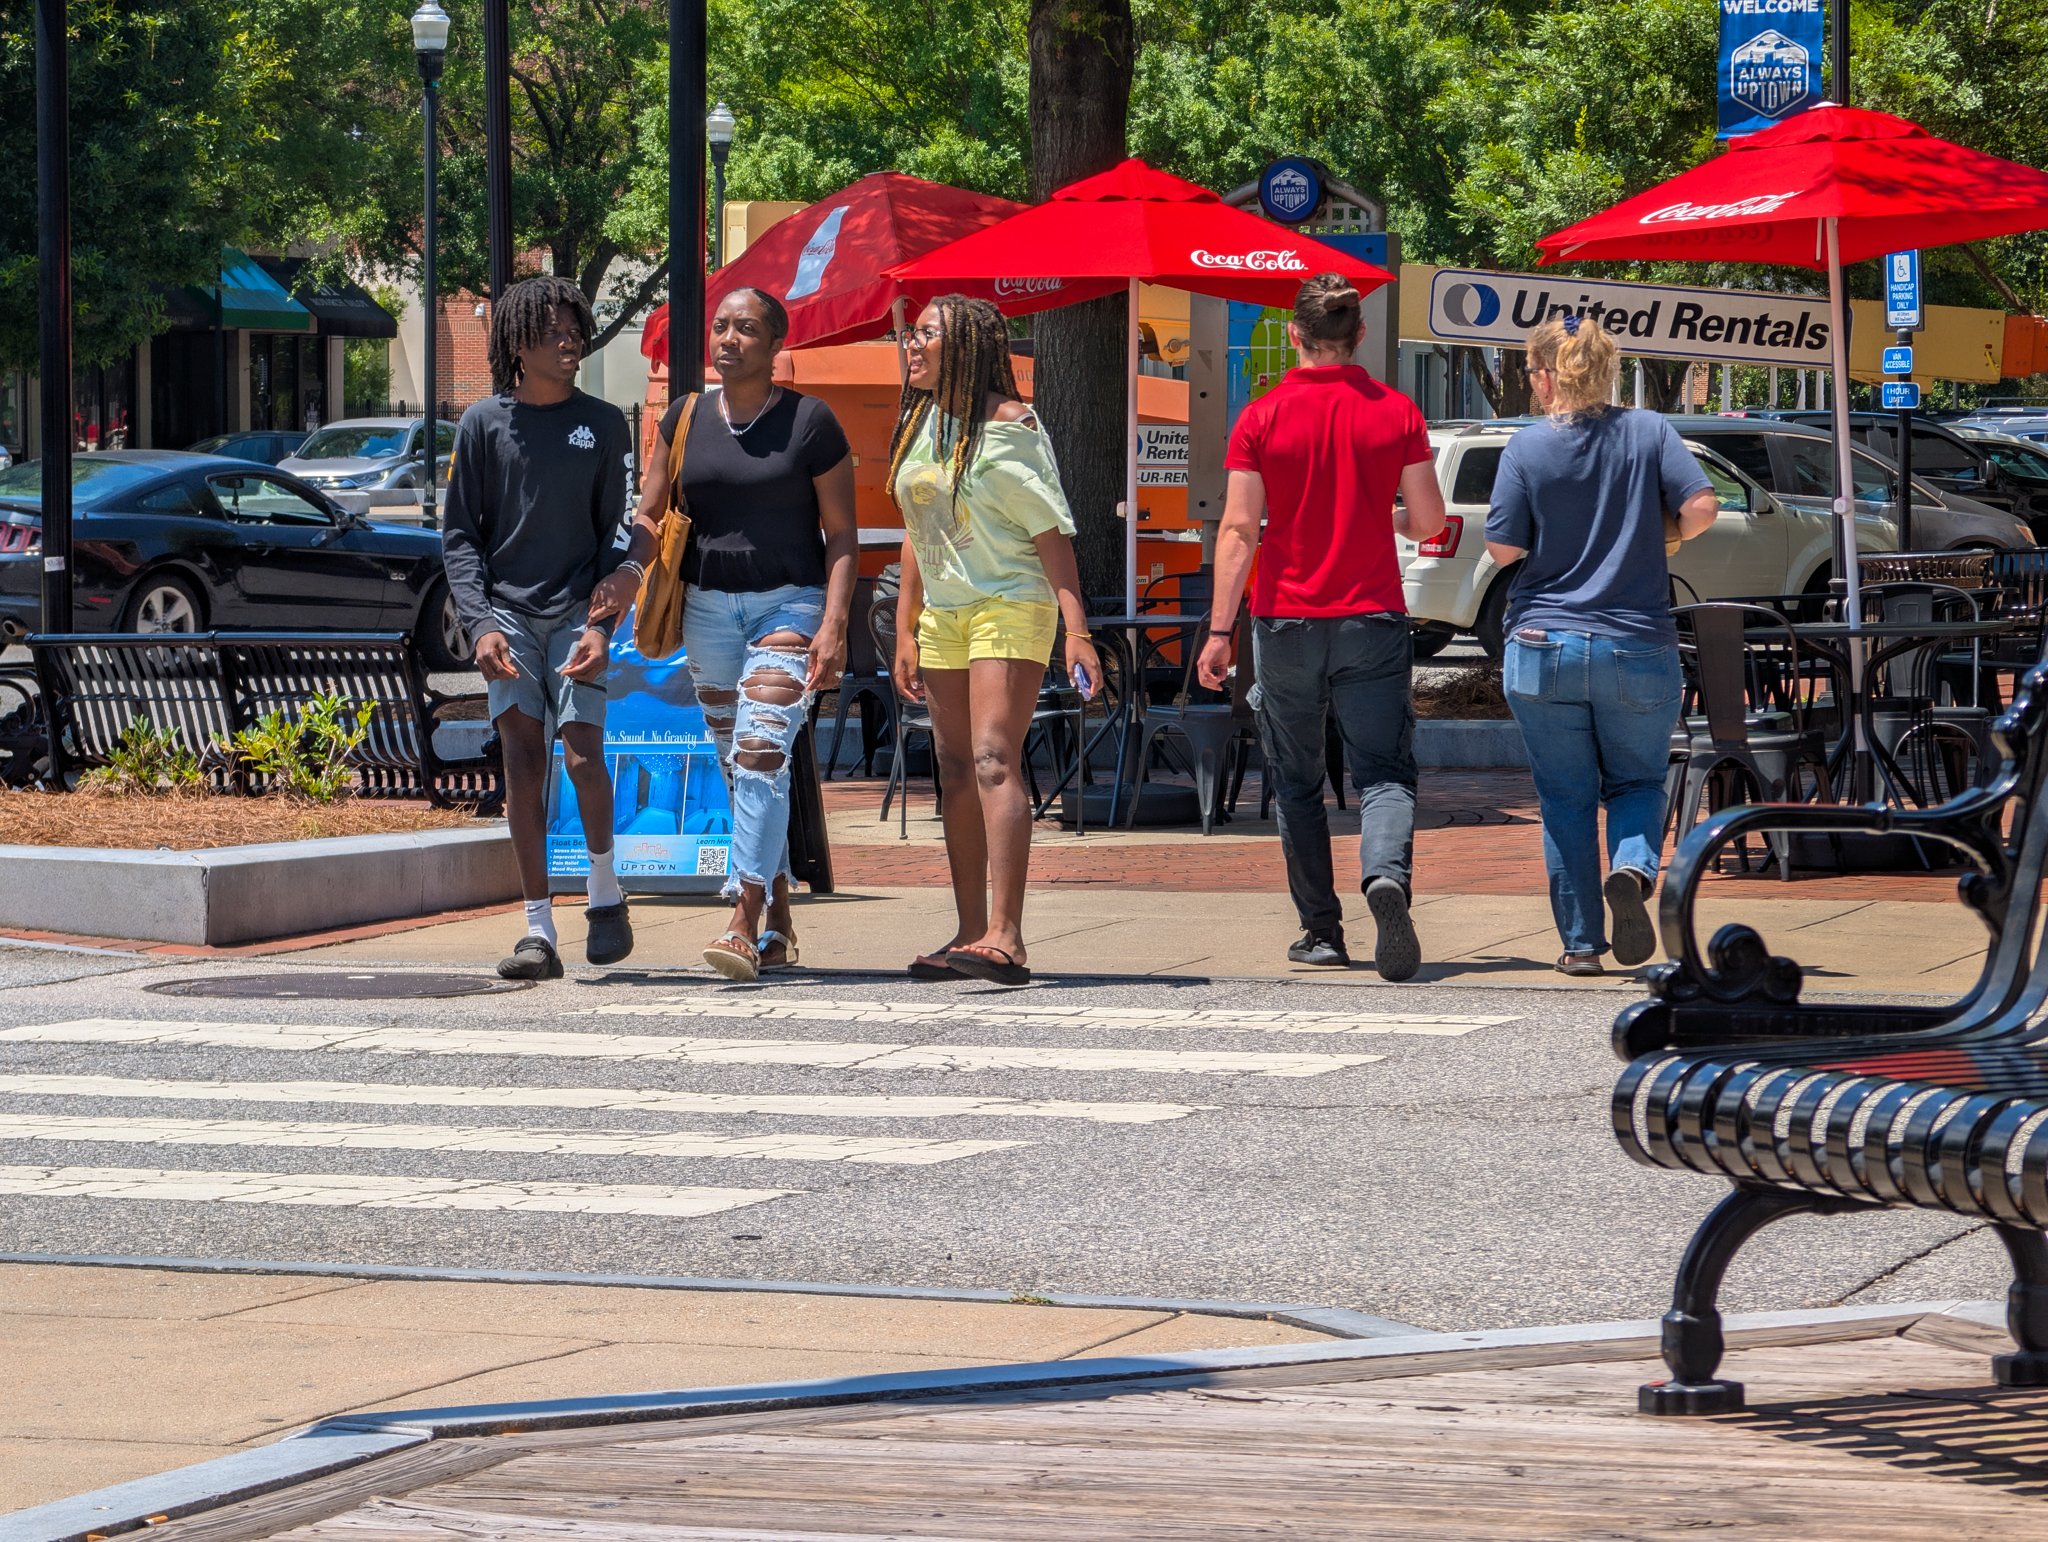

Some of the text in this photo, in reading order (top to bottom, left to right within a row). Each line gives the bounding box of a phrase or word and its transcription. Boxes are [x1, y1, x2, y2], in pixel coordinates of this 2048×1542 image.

[1723, 0, 1818, 14] WELCOME
[1739, 66, 1802, 80] ALWAYS
[1737, 80, 1802, 109] UPTOWN
[1274, 194, 1306, 208] UPTOWN
[1190, 249, 1309, 270] Coca-Cola
[1896, 301, 1909, 309] ONLY
[1512, 290, 1829, 350] United Rentals
[1892, 352, 1902, 360] VAN
[1885, 360, 1910, 369] ACCESSIBLE
[1890, 387, 1910, 395] HOUR
[568, 439, 595, 449] Kappa
[606, 730, 616, 742] No
[652, 730, 662, 742] No
[664, 730, 697, 750] Gravity
[704, 730, 714, 743] No
[551, 839, 571, 847] Float
